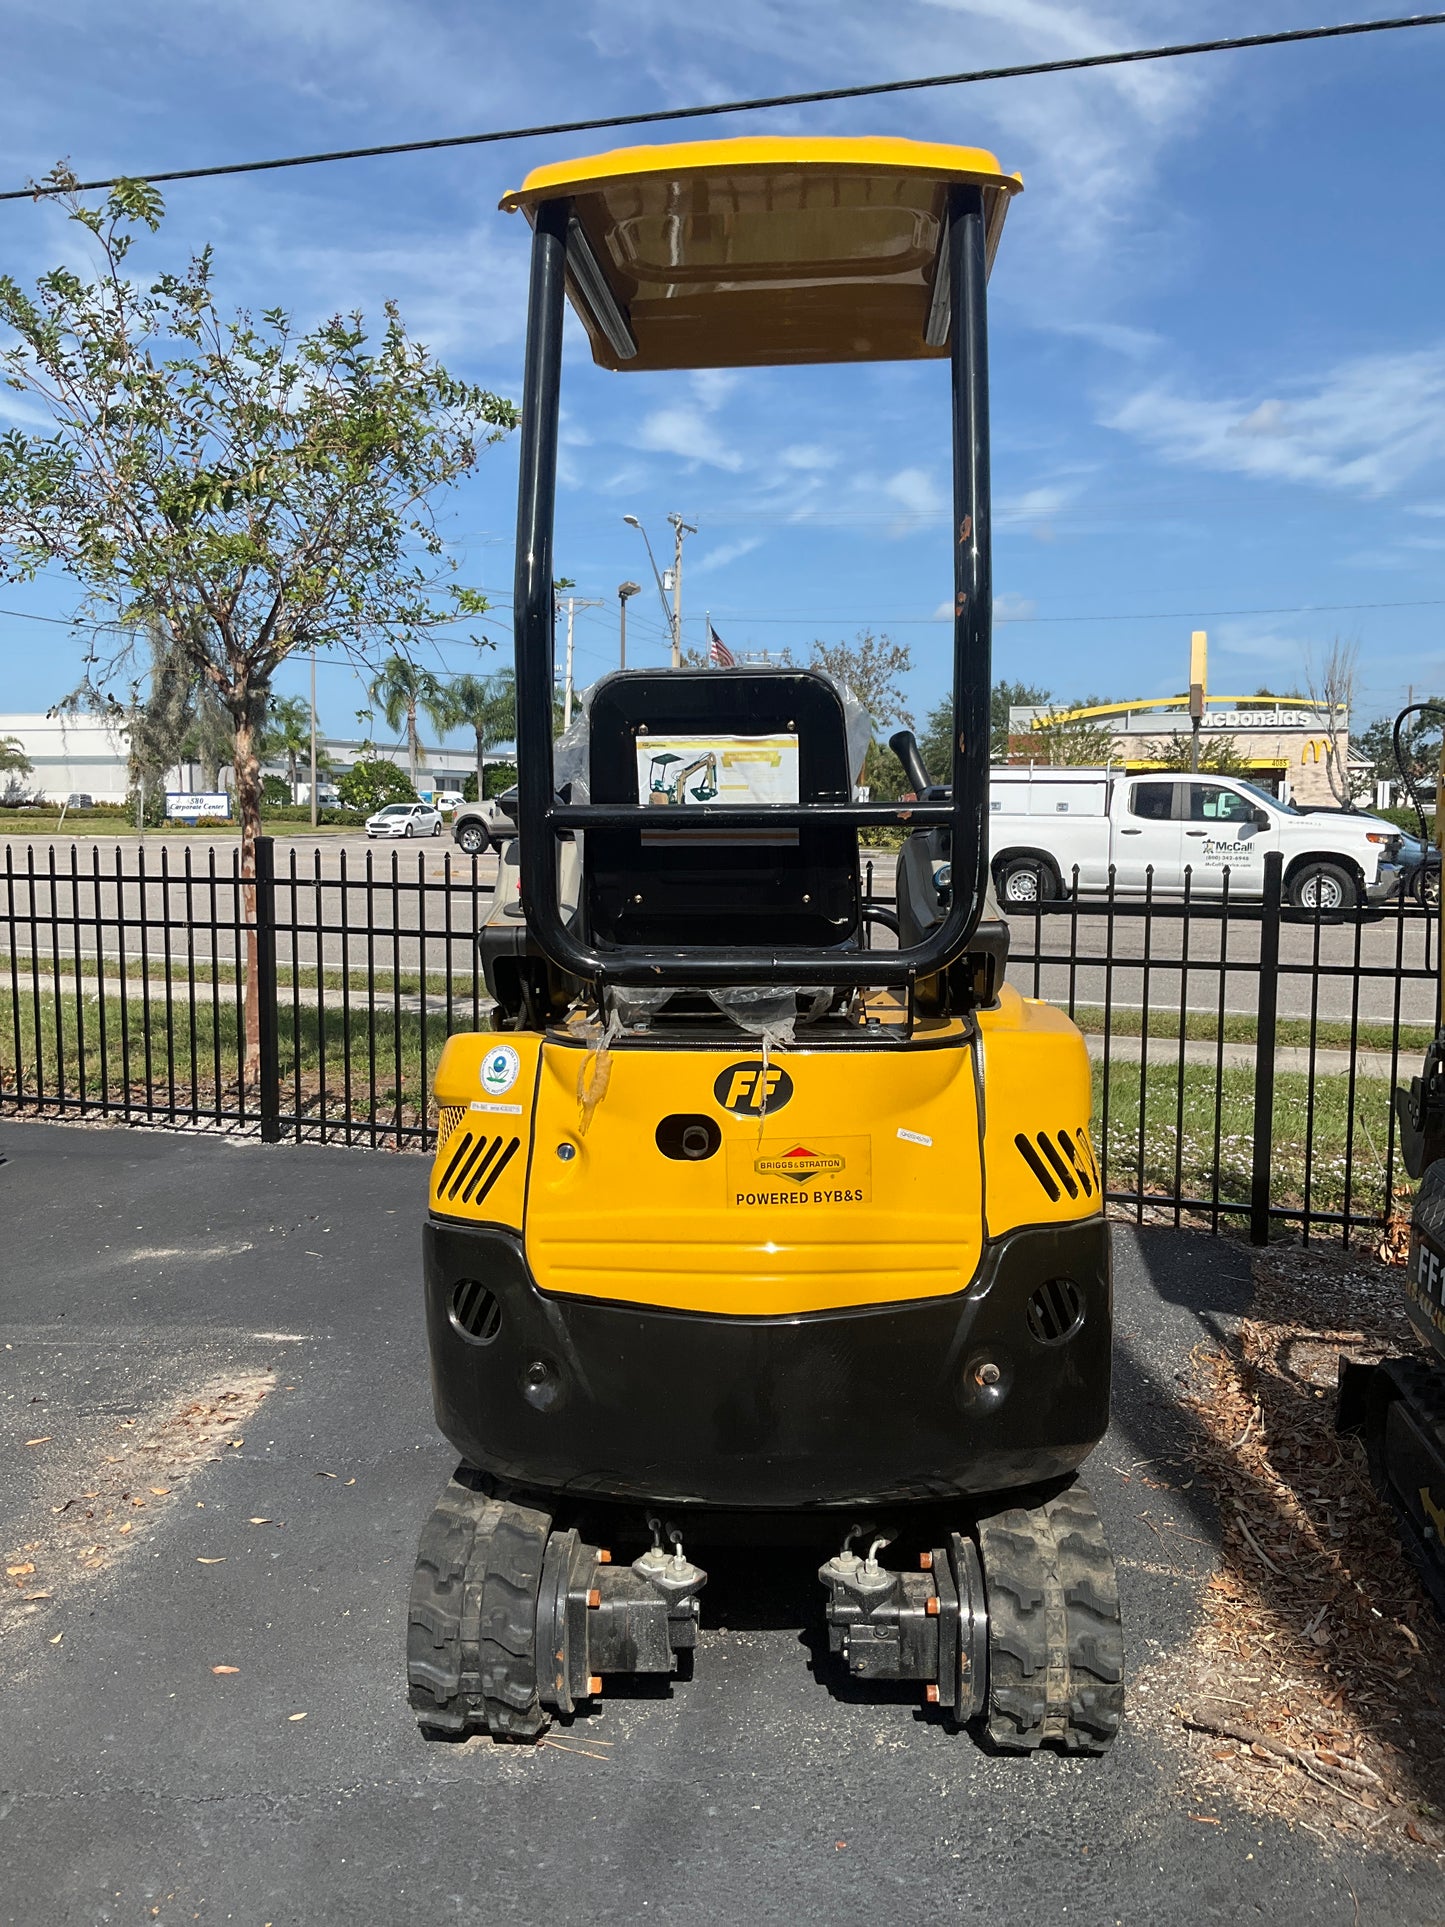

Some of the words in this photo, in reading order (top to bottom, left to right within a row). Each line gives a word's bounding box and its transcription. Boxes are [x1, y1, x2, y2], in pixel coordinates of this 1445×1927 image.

[170, 803, 202, 811] Corporate
[1215, 841, 1253, 852] McCall
[725, 1070, 782, 1108] FF
[736, 1192, 809, 1206] POWERED
